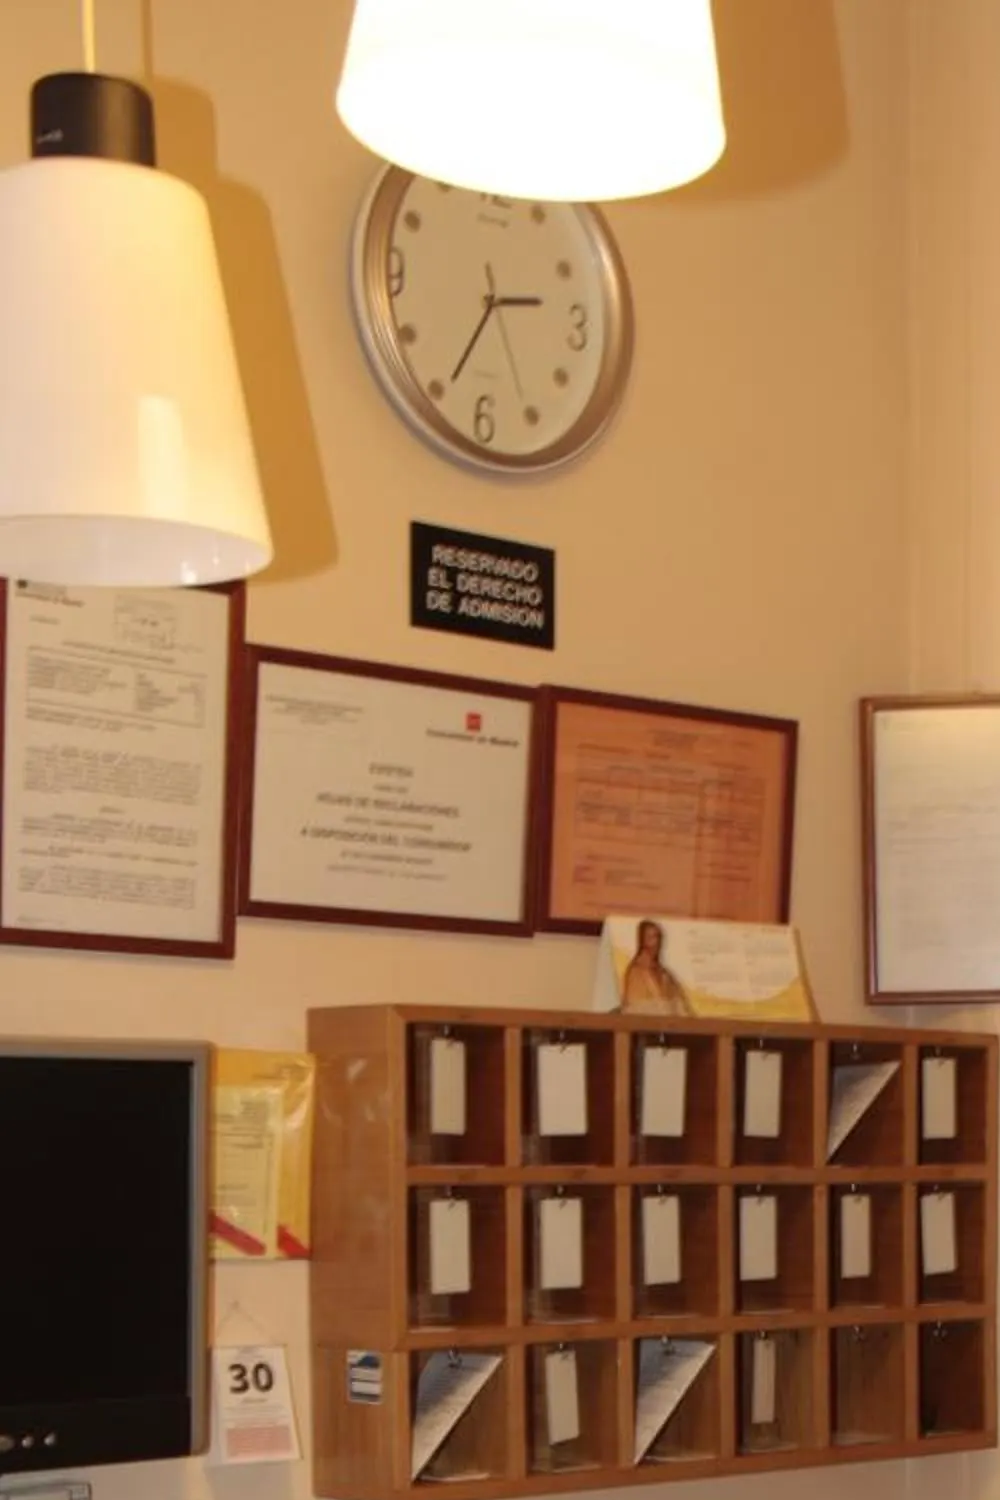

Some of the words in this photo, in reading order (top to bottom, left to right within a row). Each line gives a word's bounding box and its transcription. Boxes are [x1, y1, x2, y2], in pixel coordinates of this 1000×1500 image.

[388, 247, 403, 297] 9
[567, 303, 587, 351] 3
[473, 395, 496, 443] 6
[425, 589, 453, 614] DE
[427, 565, 452, 590] EL
[456, 572, 543, 606] DERECHO
[228, 1363, 274, 1394] 30
